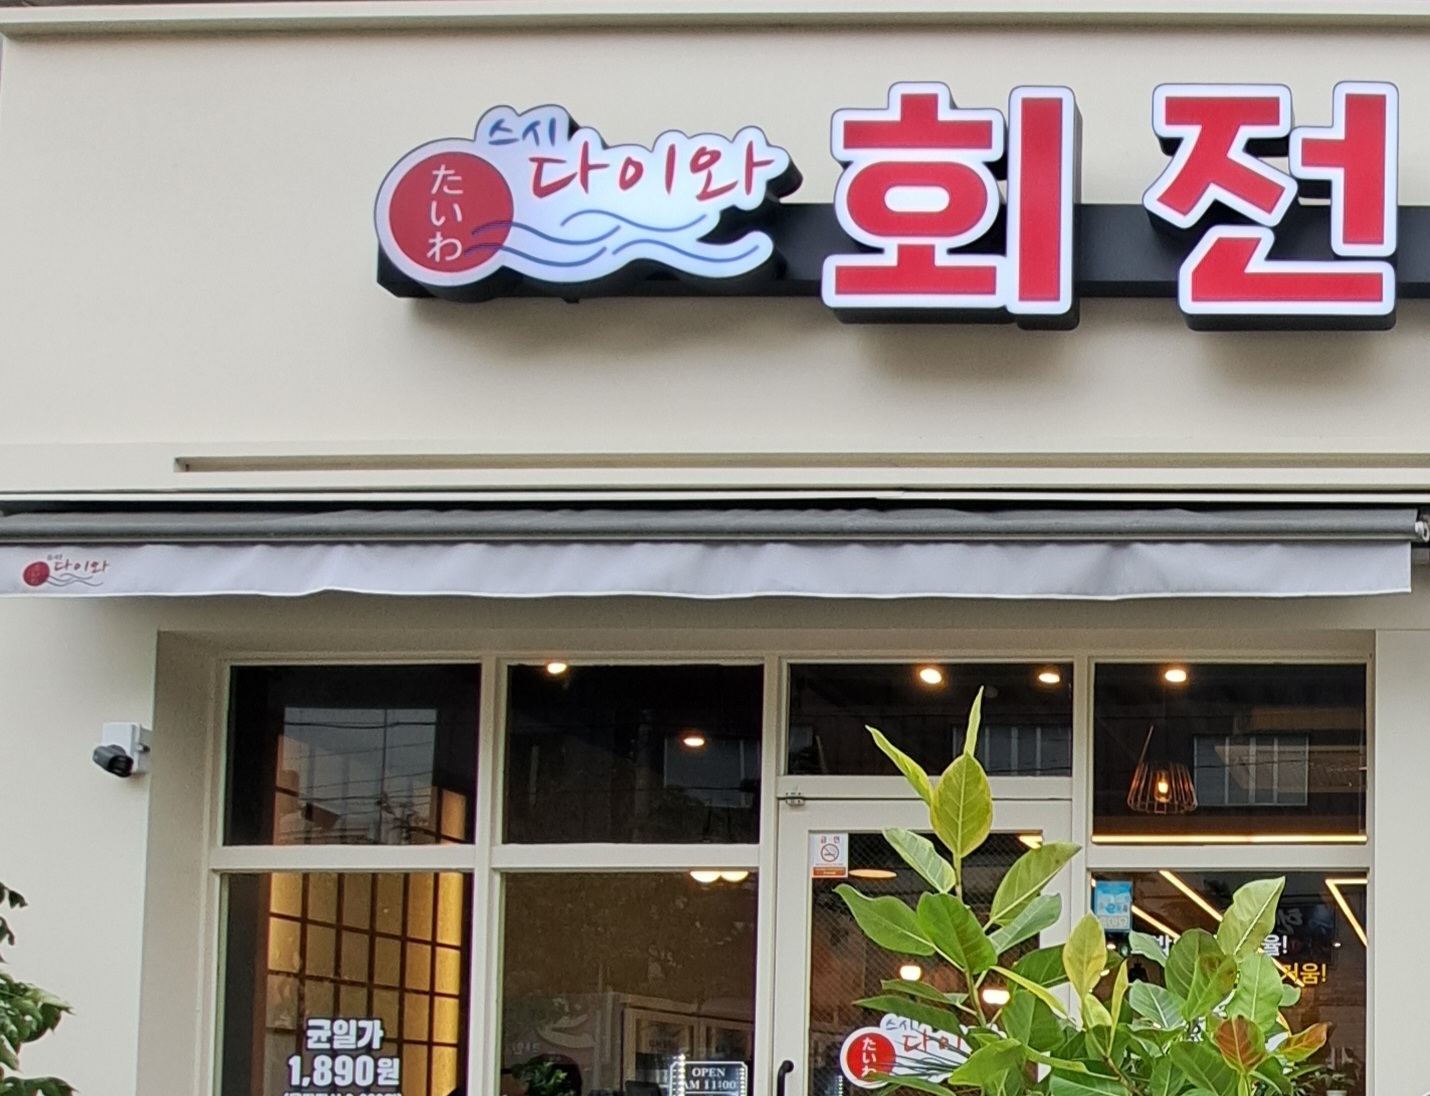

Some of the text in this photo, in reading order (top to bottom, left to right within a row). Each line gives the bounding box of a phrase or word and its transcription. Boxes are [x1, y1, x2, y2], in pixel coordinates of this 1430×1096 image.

[487, 115, 557, 147] 스시
[527, 139, 777, 201] 다이와
[426, 163, 464, 263] たいわ
[54, 559, 109, 574] 다이와
[307, 1018, 384, 1050] 균일가
[288, 1053, 401, 1088] 1,890원
[691, 1067, 726, 1077] OPEN
[704, 1080, 737, 1090] 11:00
